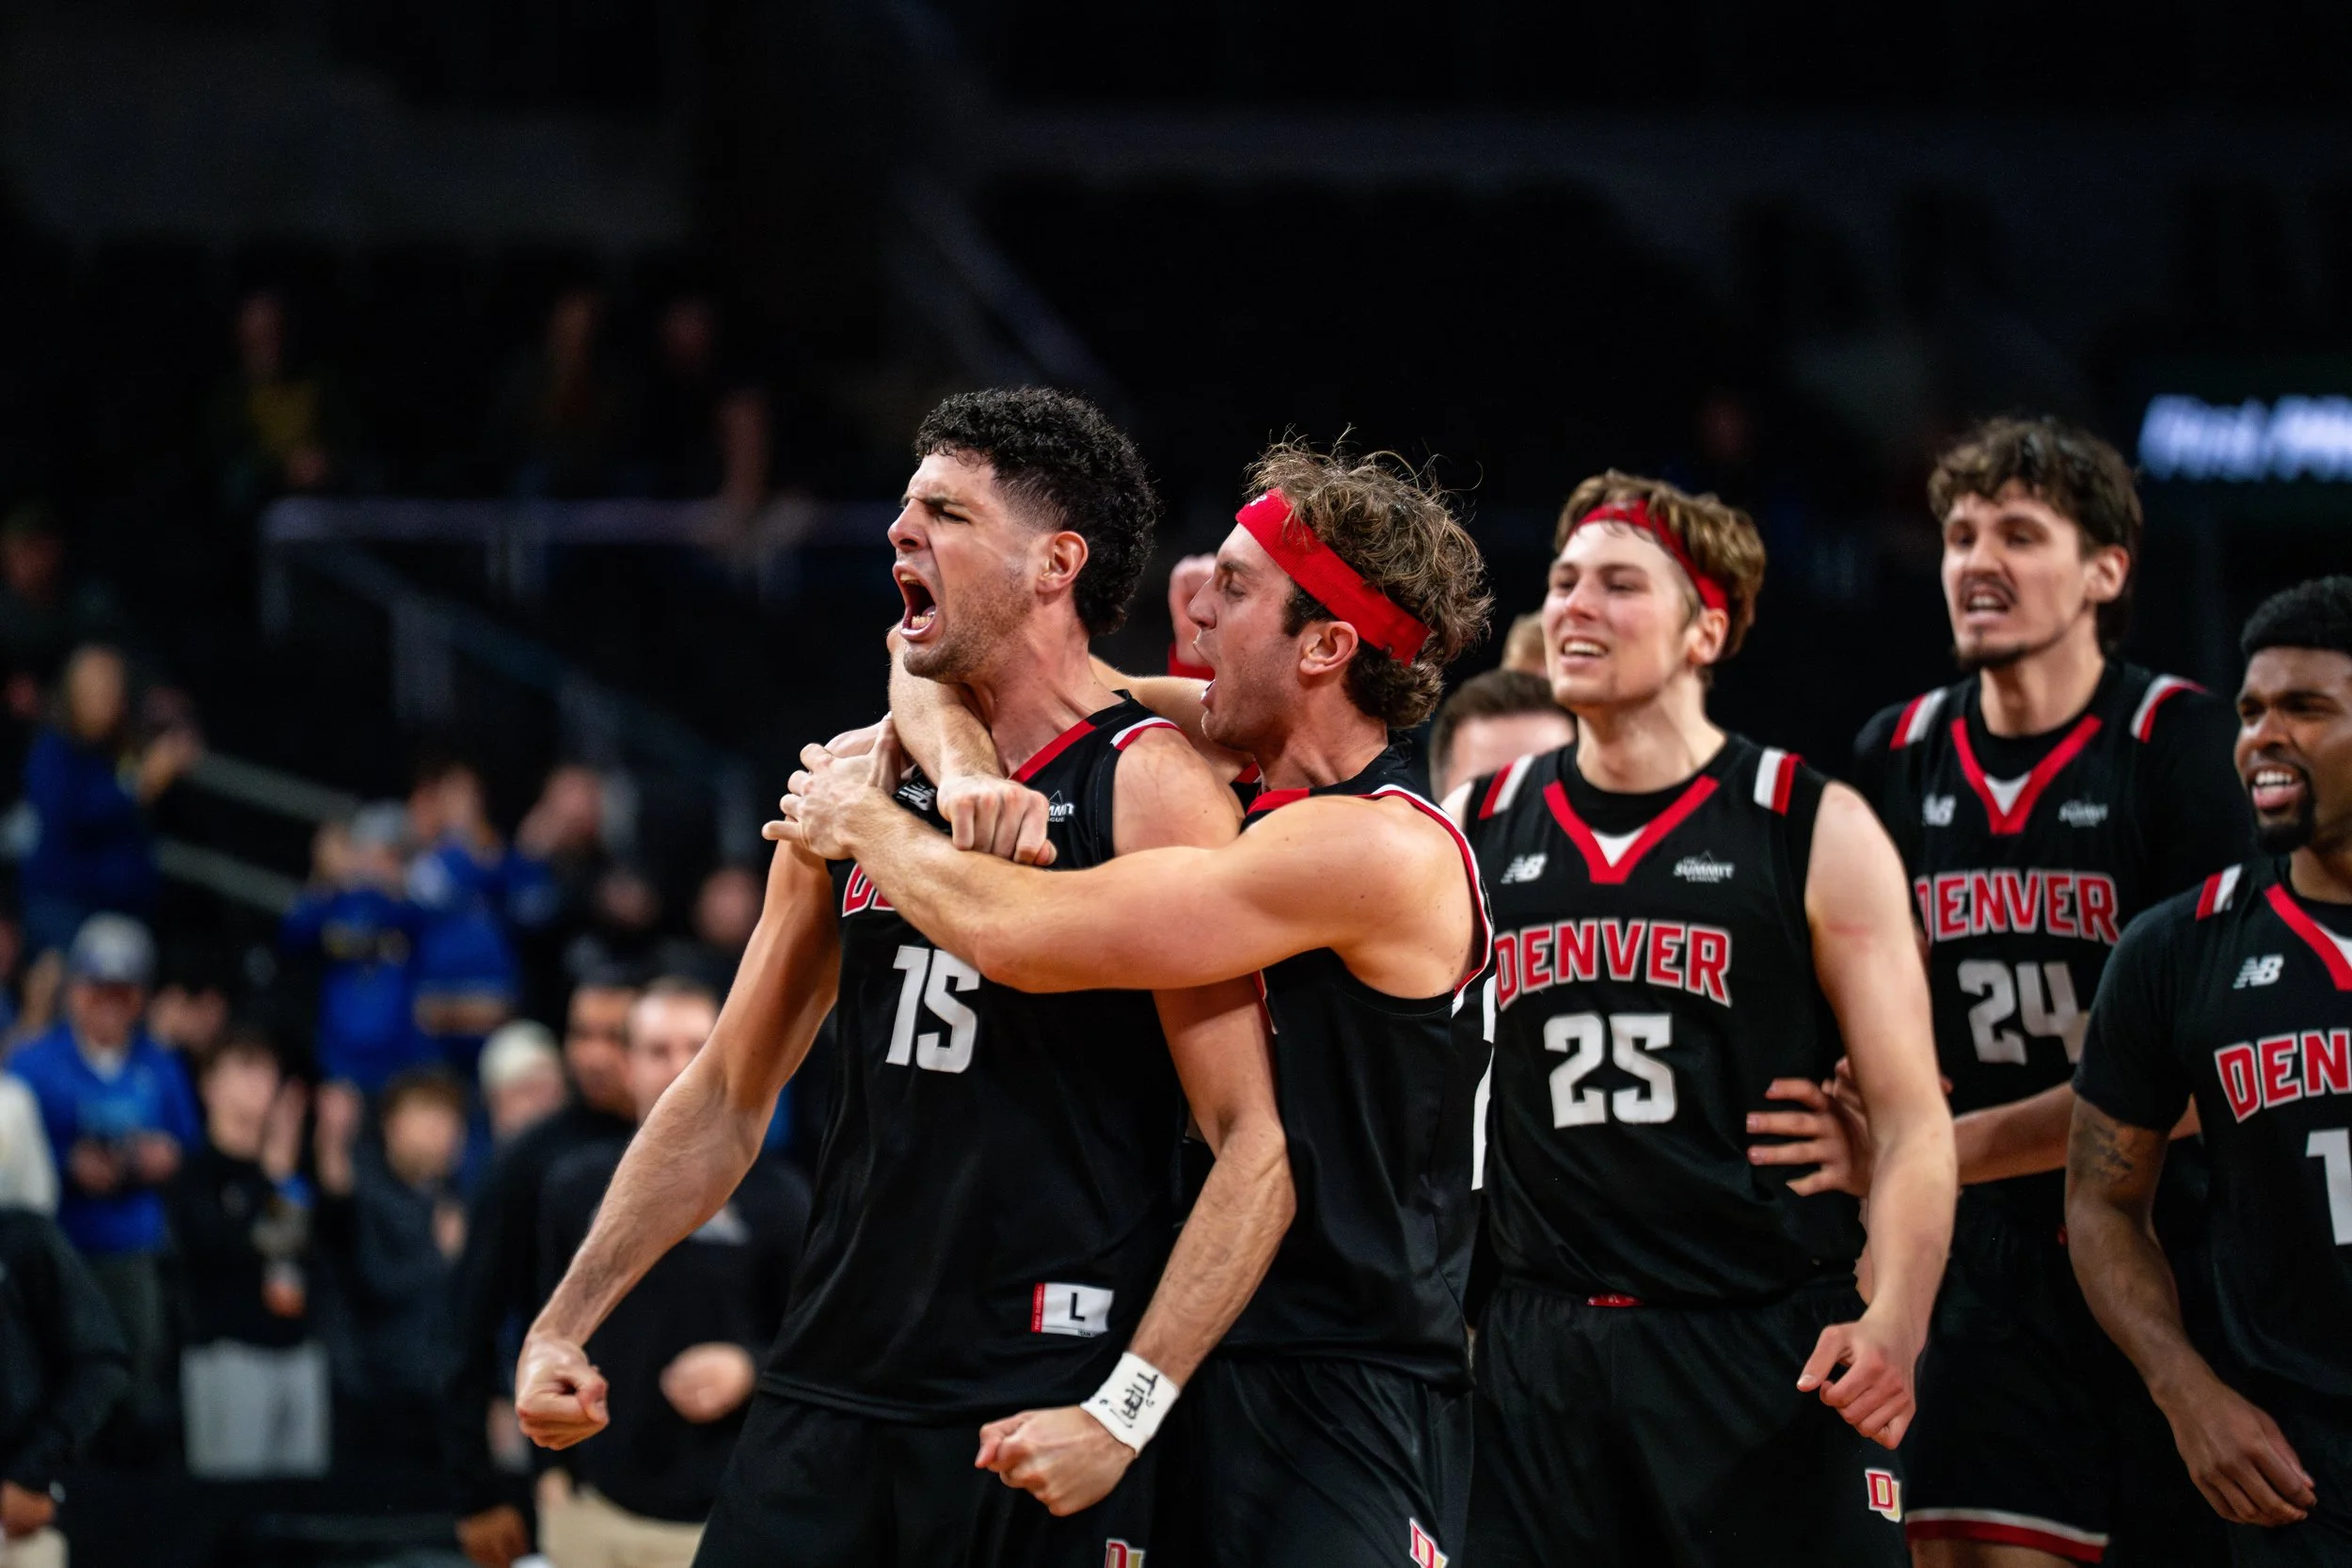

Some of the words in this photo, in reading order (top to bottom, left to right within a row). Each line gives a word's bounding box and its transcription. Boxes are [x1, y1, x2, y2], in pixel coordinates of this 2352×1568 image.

[885, 944, 980, 1074] 15
[1494, 917, 1732, 1013] DENVER
[1957, 958, 2090, 1066] 24
[1543, 1011, 1678, 1130] 25
[1069, 1291, 1086, 1323] L
